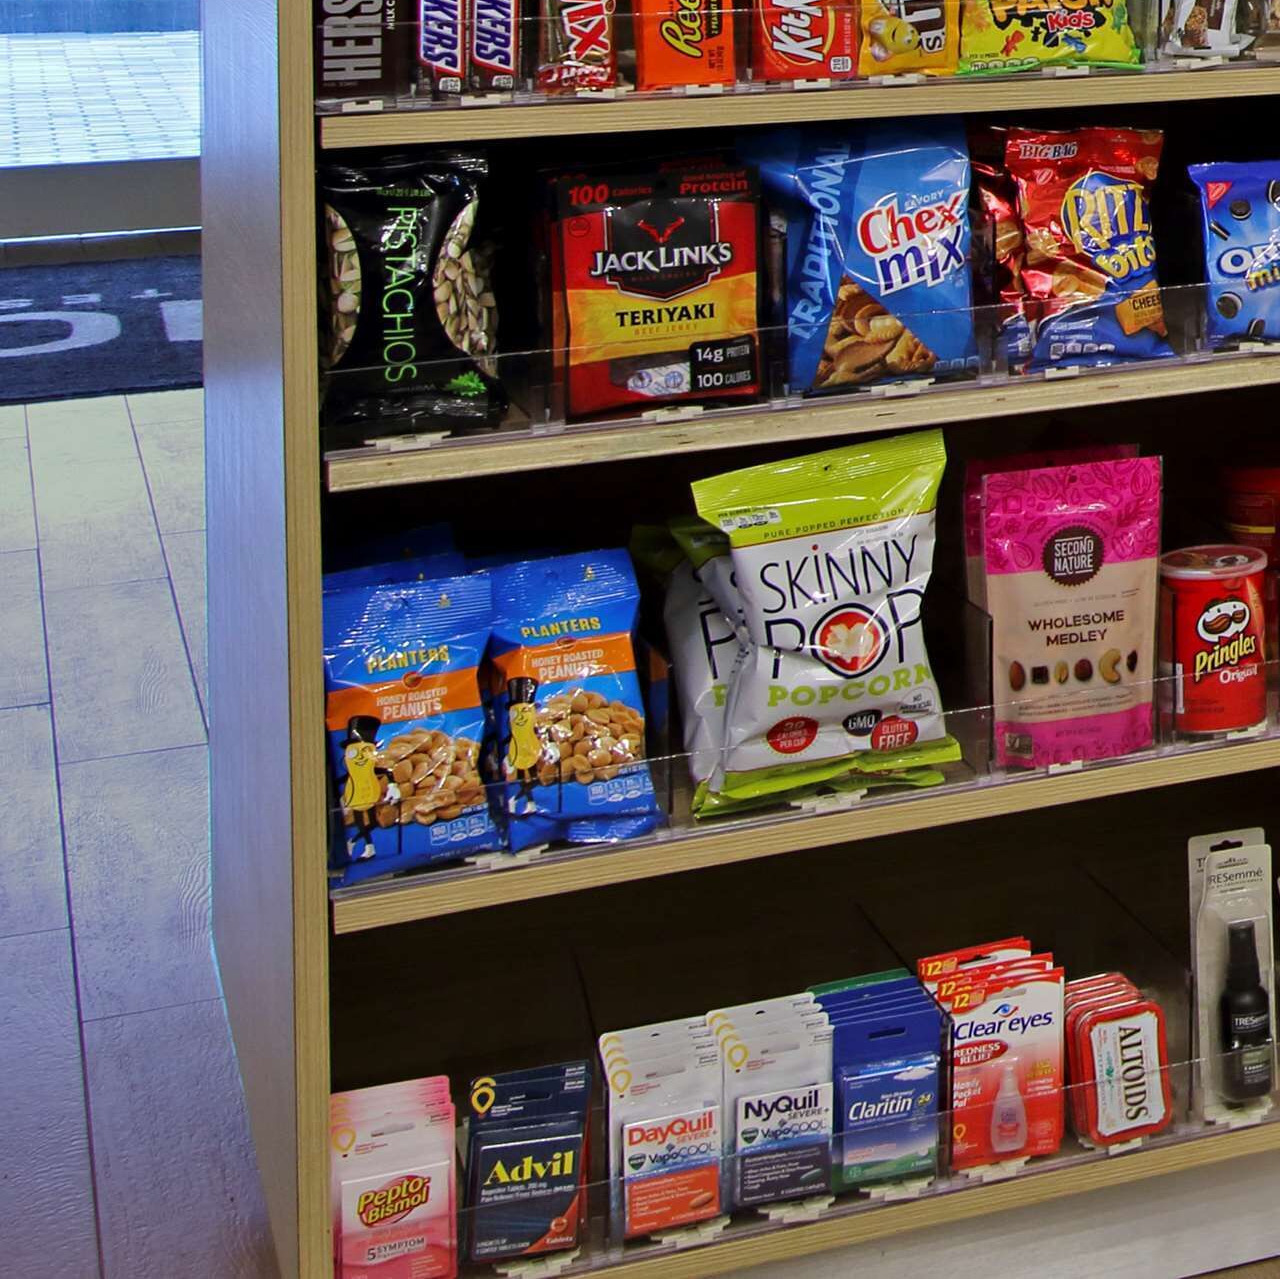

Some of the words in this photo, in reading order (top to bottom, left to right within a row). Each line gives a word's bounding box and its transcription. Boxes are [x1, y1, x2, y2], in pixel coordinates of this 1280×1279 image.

[386, 8, 396, 31] MILK
[1046, 10, 1095, 32] Kids
[1020, 144, 1050, 159] BIG
[569, 184, 609, 206] 100
[680, 178, 748, 195] Protein
[904, 189, 945, 211] SAVORY
[858, 188, 969, 256] Chex
[1066, 184, 1149, 254] RITZ
[790, 144, 852, 341] TRADITIONAL
[591, 249, 660, 277] JACK
[659, 242, 732, 269] LINK'S
[879, 230, 966, 292] mix
[382, 207, 417, 382] PISTACHIOS
[616, 303, 716, 327] TERIYAKI
[634, 327, 660, 336] BEEF
[666, 323, 698, 333] JERKY
[696, 347, 724, 363] 14g
[726, 344, 750, 357] PROTEIN
[697, 372, 723, 388] 100
[764, 530, 790, 540] PURE
[796, 521, 835, 534] POPPED
[839, 508, 905, 527] PERFECTION
[1054, 536, 1094, 556] SECOND
[760, 534, 917, 614] SKINNY
[1054, 554, 1094, 572] NATURE
[521, 616, 601, 639] PLANTERS
[1027, 610, 1125, 632] WHOLESOME
[763, 588, 924, 680] POP
[1046, 629, 1108, 647] MEDLEY
[367, 644, 450, 674] PLANTERS
[531, 655, 562, 668] HONEY
[564, 648, 604, 663] ROASTED
[1195, 633, 1257, 683] Pringles
[377, 694, 406, 707] HONEY
[408, 686, 447, 702] ROASTED
[767, 664, 932, 708] POPCORN
[382, 699, 442, 720] PEANUTS
[881, 722, 910, 734] GLUTEN
[879, 732, 911, 749] FREE
[927, 960, 943, 975] 12
[953, 993, 970, 1009] 12
[955, 1019, 1007, 1041] Clear
[1008, 1011, 1053, 1035] eyes
[953, 1041, 1001, 1059] REDNESS
[1118, 1025, 1149, 1122] ALTOIDS
[744, 1090, 819, 1122] NyQuil
[849, 1095, 913, 1121] Claritin
[628, 1111, 714, 1146] DayQuil
[761, 1118, 826, 1140] VapoCOOL
[648, 1142, 715, 1165] VapoCOOL
[483, 1149, 574, 1185] Advil
[367, 1186, 428, 1222] Bismol
[367, 1248, 376, 1261] 5
[377, 1237, 426, 1254] SYMPTOM
